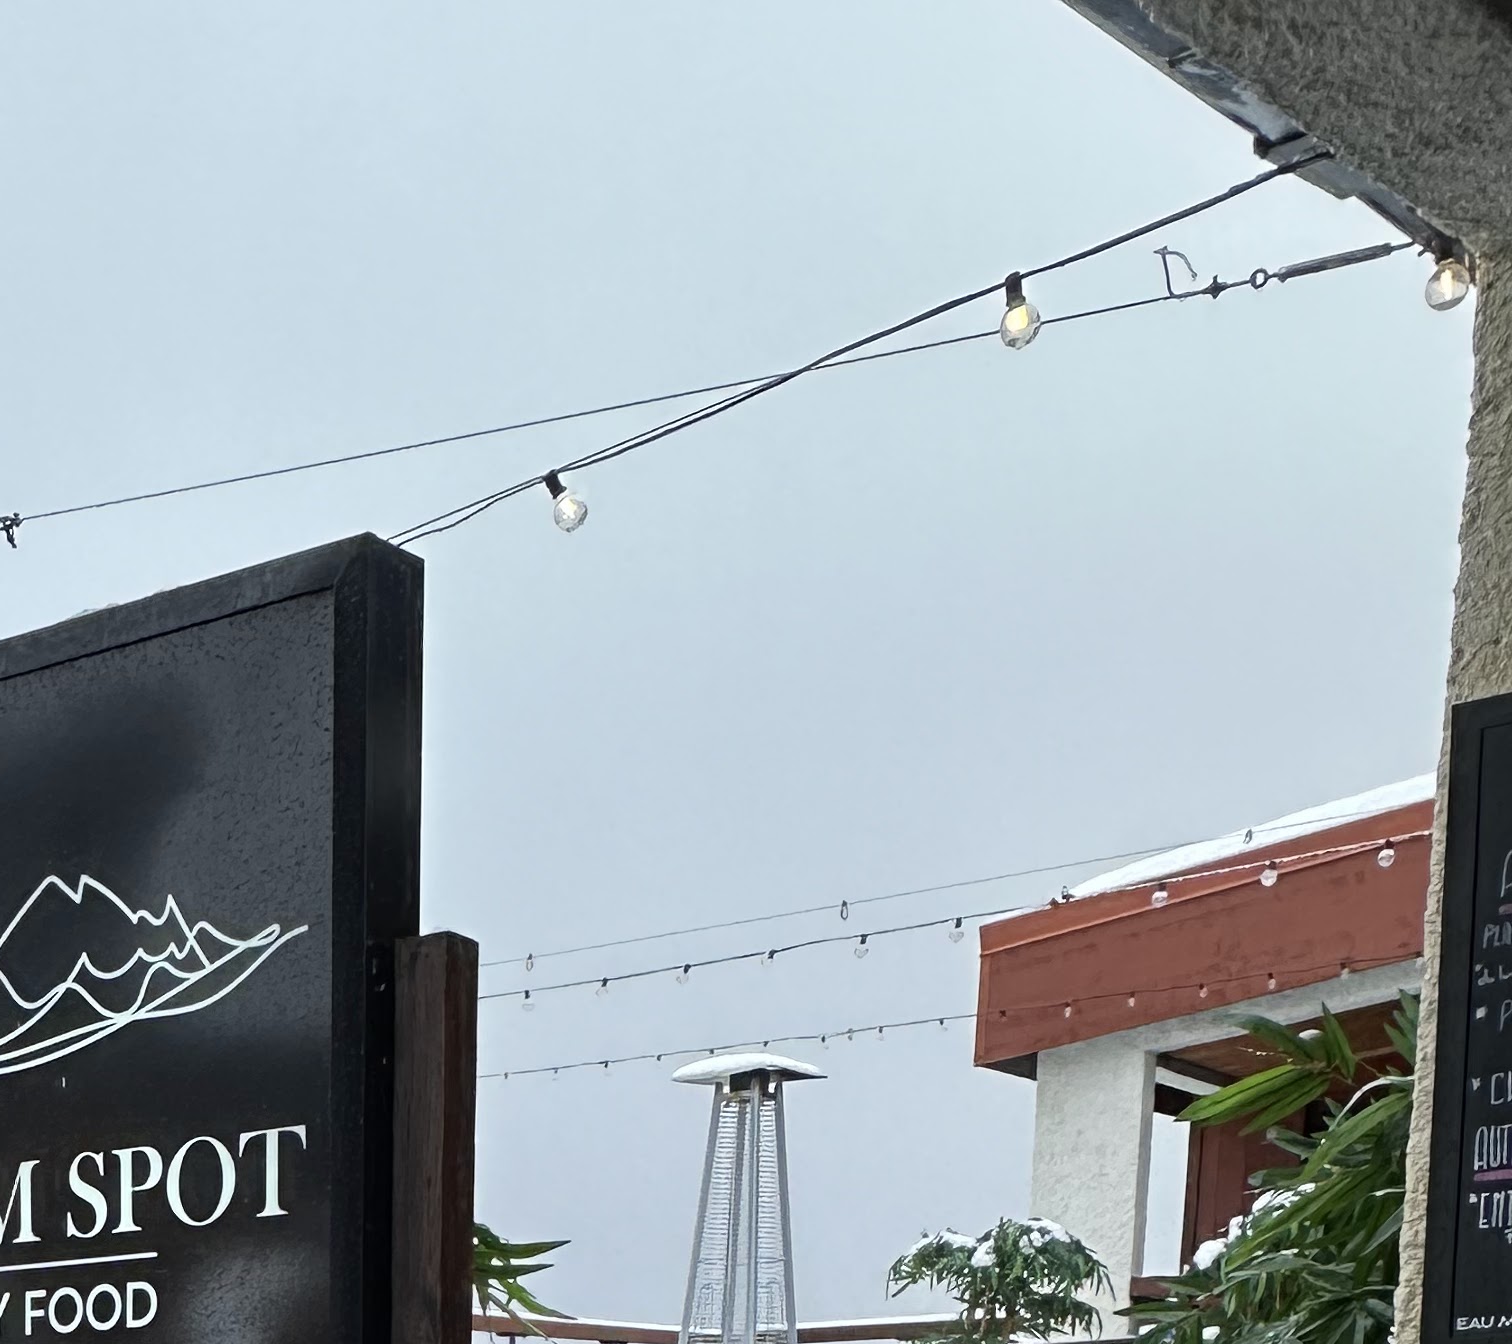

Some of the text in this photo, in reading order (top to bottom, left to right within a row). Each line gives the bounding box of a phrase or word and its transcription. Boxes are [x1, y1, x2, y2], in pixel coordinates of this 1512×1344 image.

[66, 1124, 307, 1238] SPOT
[24, 1281, 158, 1336] FOOD
[1456, 1315, 1495, 1331] EAU
